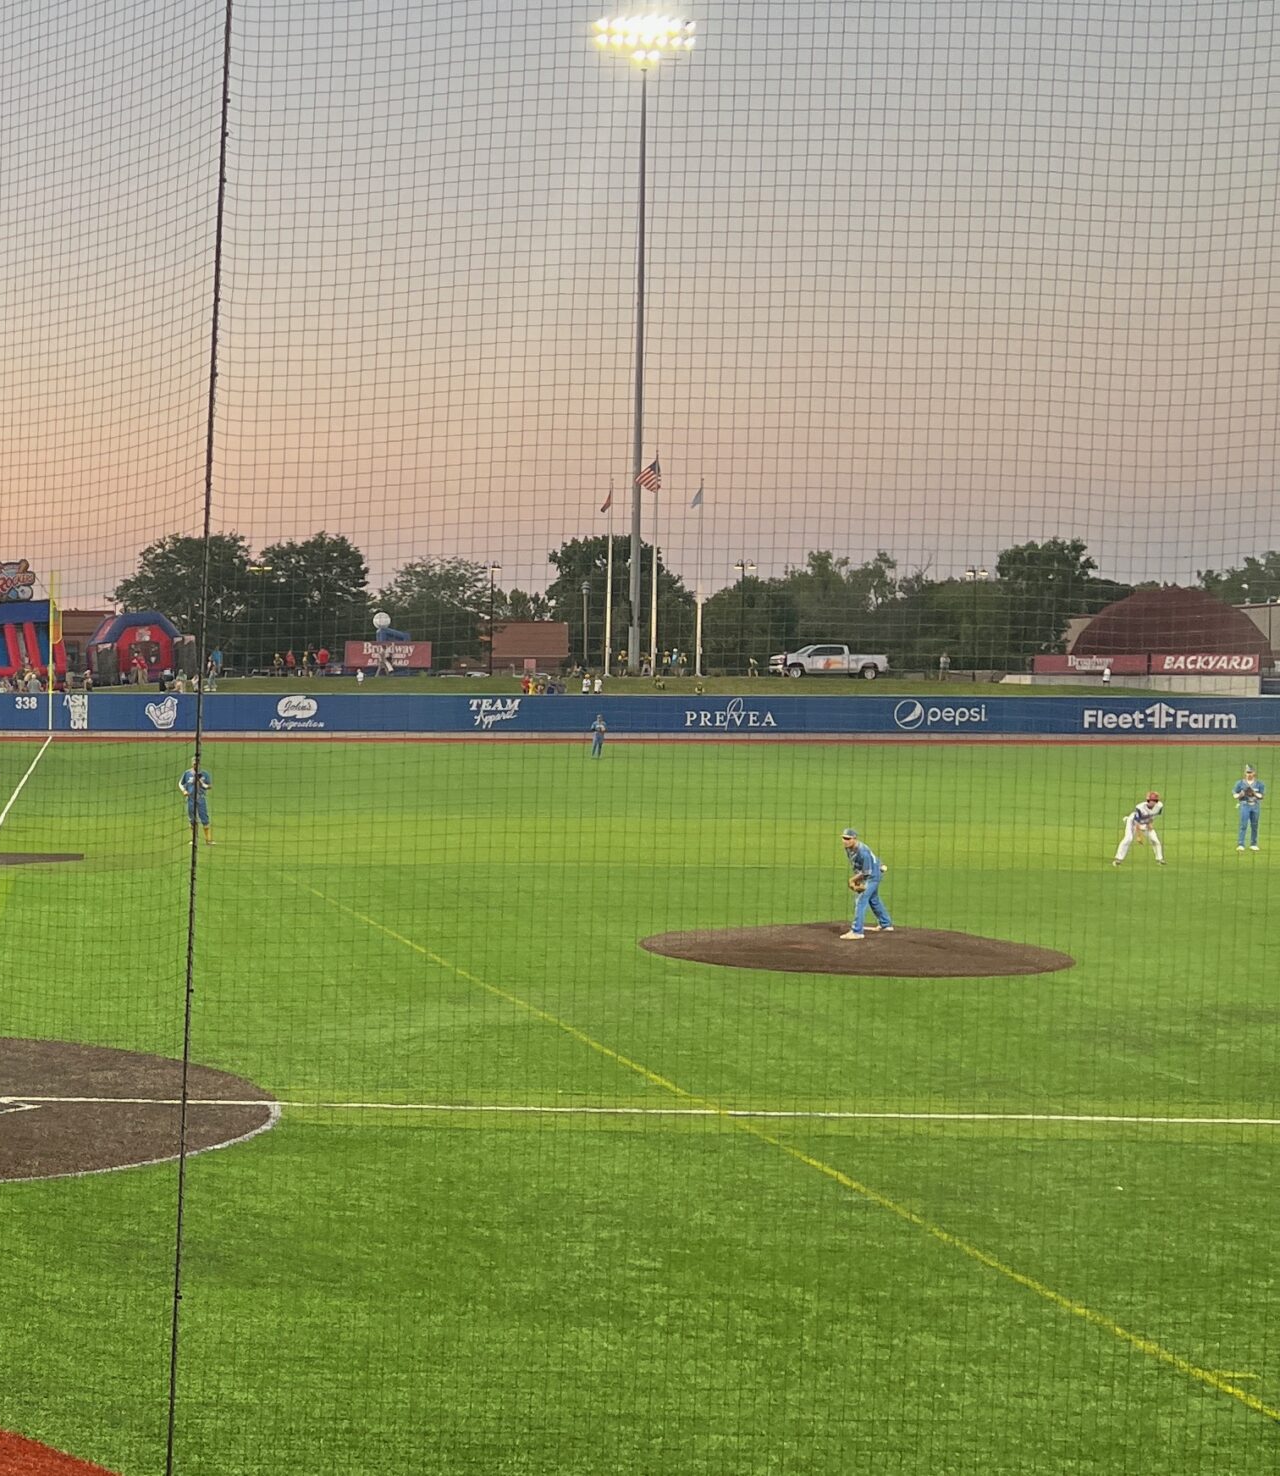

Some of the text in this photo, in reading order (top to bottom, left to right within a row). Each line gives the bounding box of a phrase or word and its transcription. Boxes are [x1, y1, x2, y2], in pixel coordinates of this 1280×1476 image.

[363, 642, 415, 656] Brodway
[1163, 655, 1254, 670] BACKYARD
[15, 696, 38, 709] 338
[469, 698, 521, 710] TEAM
[685, 711, 777, 726] PREVEA
[927, 704, 986, 726] pepsi
[1083, 709, 1237, 728] Fleet Farm
